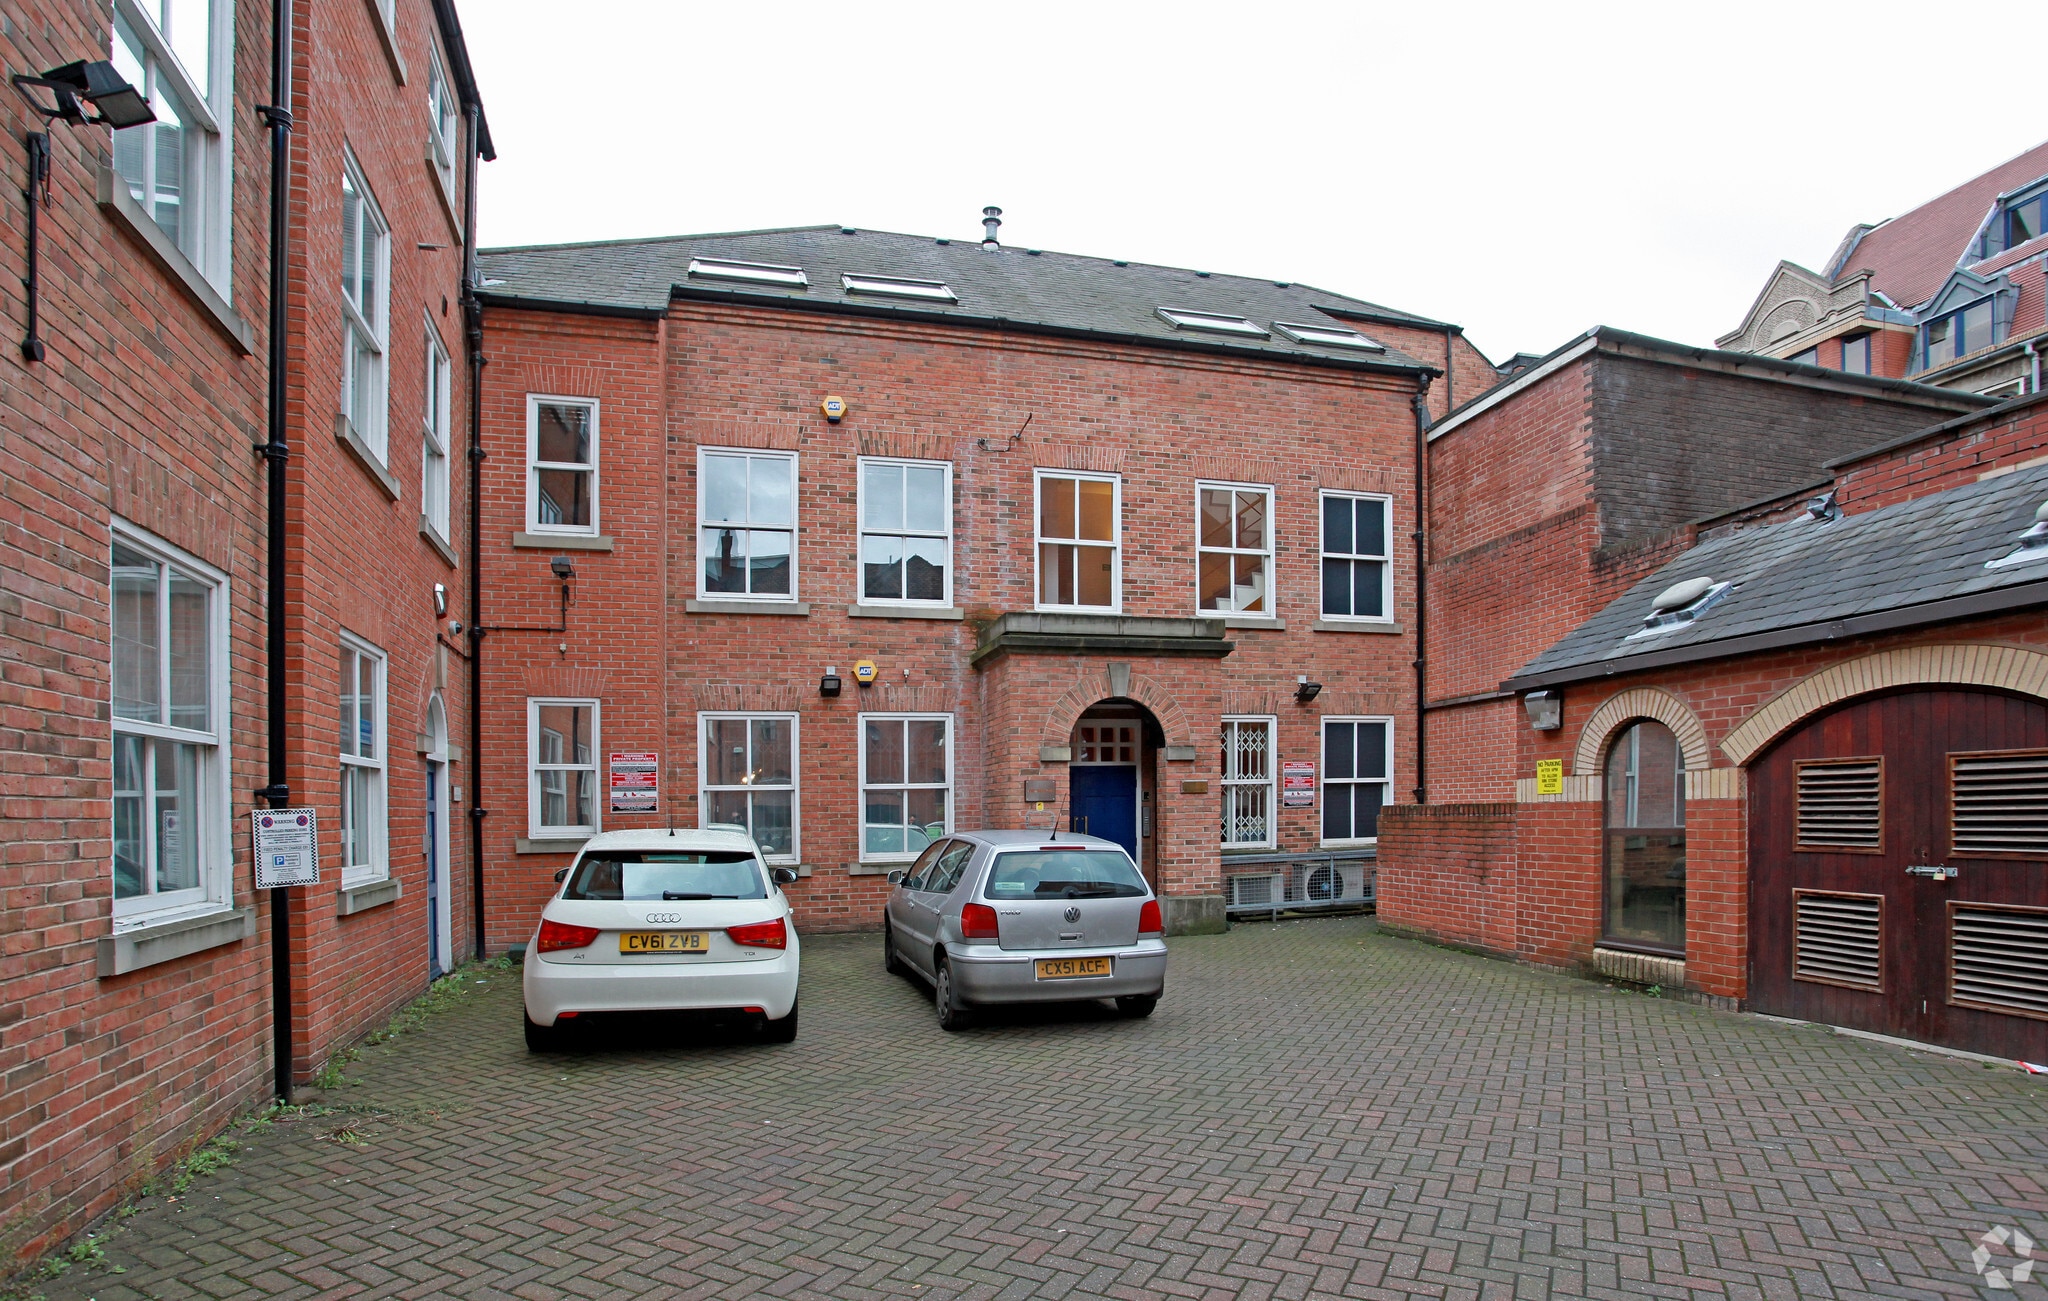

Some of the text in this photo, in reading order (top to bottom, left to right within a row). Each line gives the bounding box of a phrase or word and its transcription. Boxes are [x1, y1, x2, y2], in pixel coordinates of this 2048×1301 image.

[827, 401, 841, 410] ADT
[859, 667, 872, 675] ADT
[629, 934, 700, 948] CV61 ZVB
[1045, 960, 1103, 975] CX51 ACF
